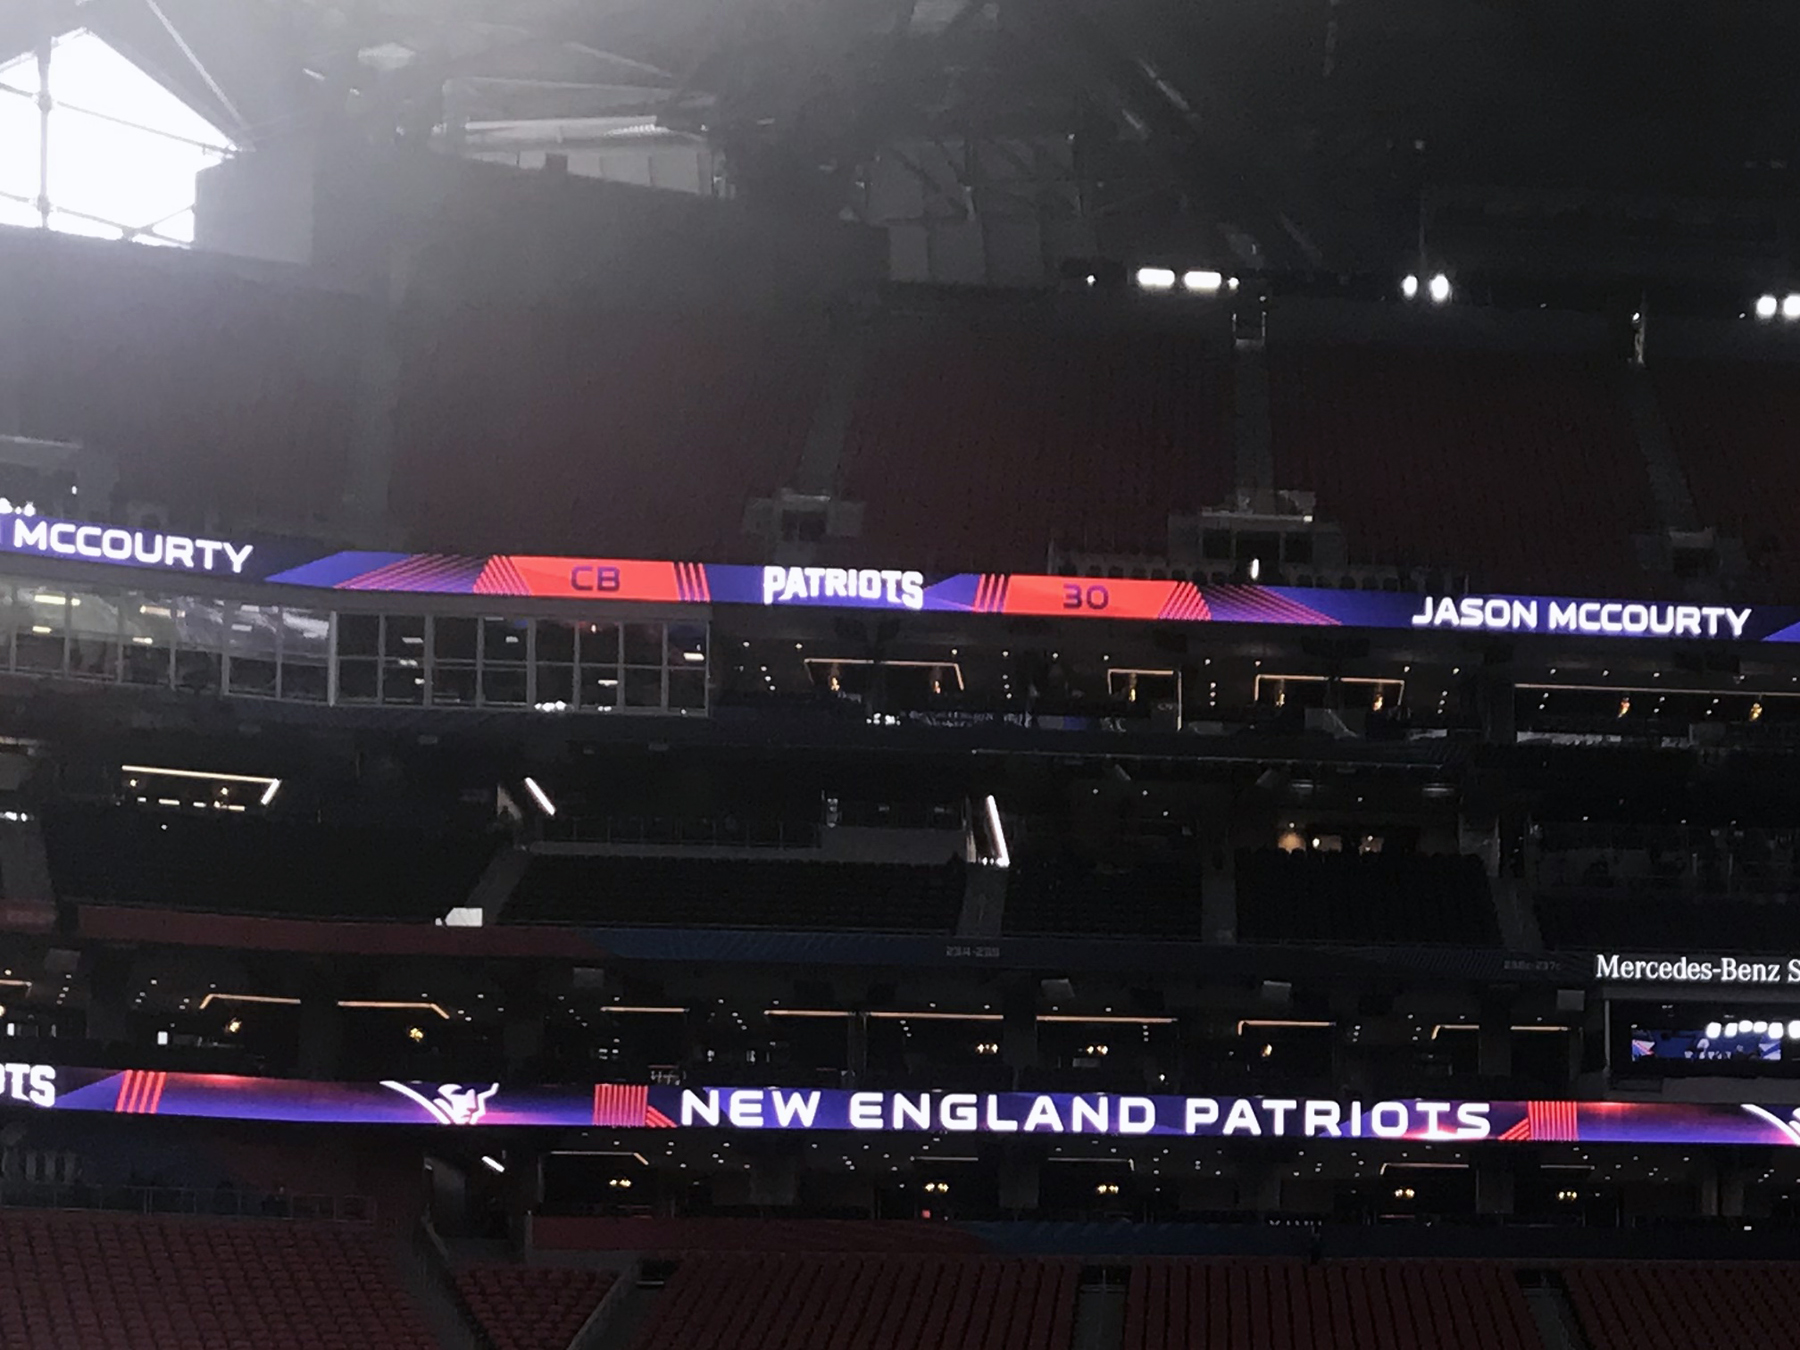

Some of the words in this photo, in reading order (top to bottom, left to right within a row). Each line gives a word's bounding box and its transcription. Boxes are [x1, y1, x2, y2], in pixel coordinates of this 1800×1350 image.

[13, 517, 254, 575] MCCOURTY
[571, 566, 620, 592] CB
[763, 565, 925, 611] PATRIOTS
[1063, 584, 1110, 611] 30
[1412, 597, 1539, 630] JASON
[1549, 602, 1753, 637] MCCOURTY
[1596, 954, 1781, 983] Mercedes-Benz
[682, 1088, 820, 1129] NEW
[850, 1093, 1156, 1135] ENGLAND
[1186, 1099, 1492, 1138] PATRIOTS
